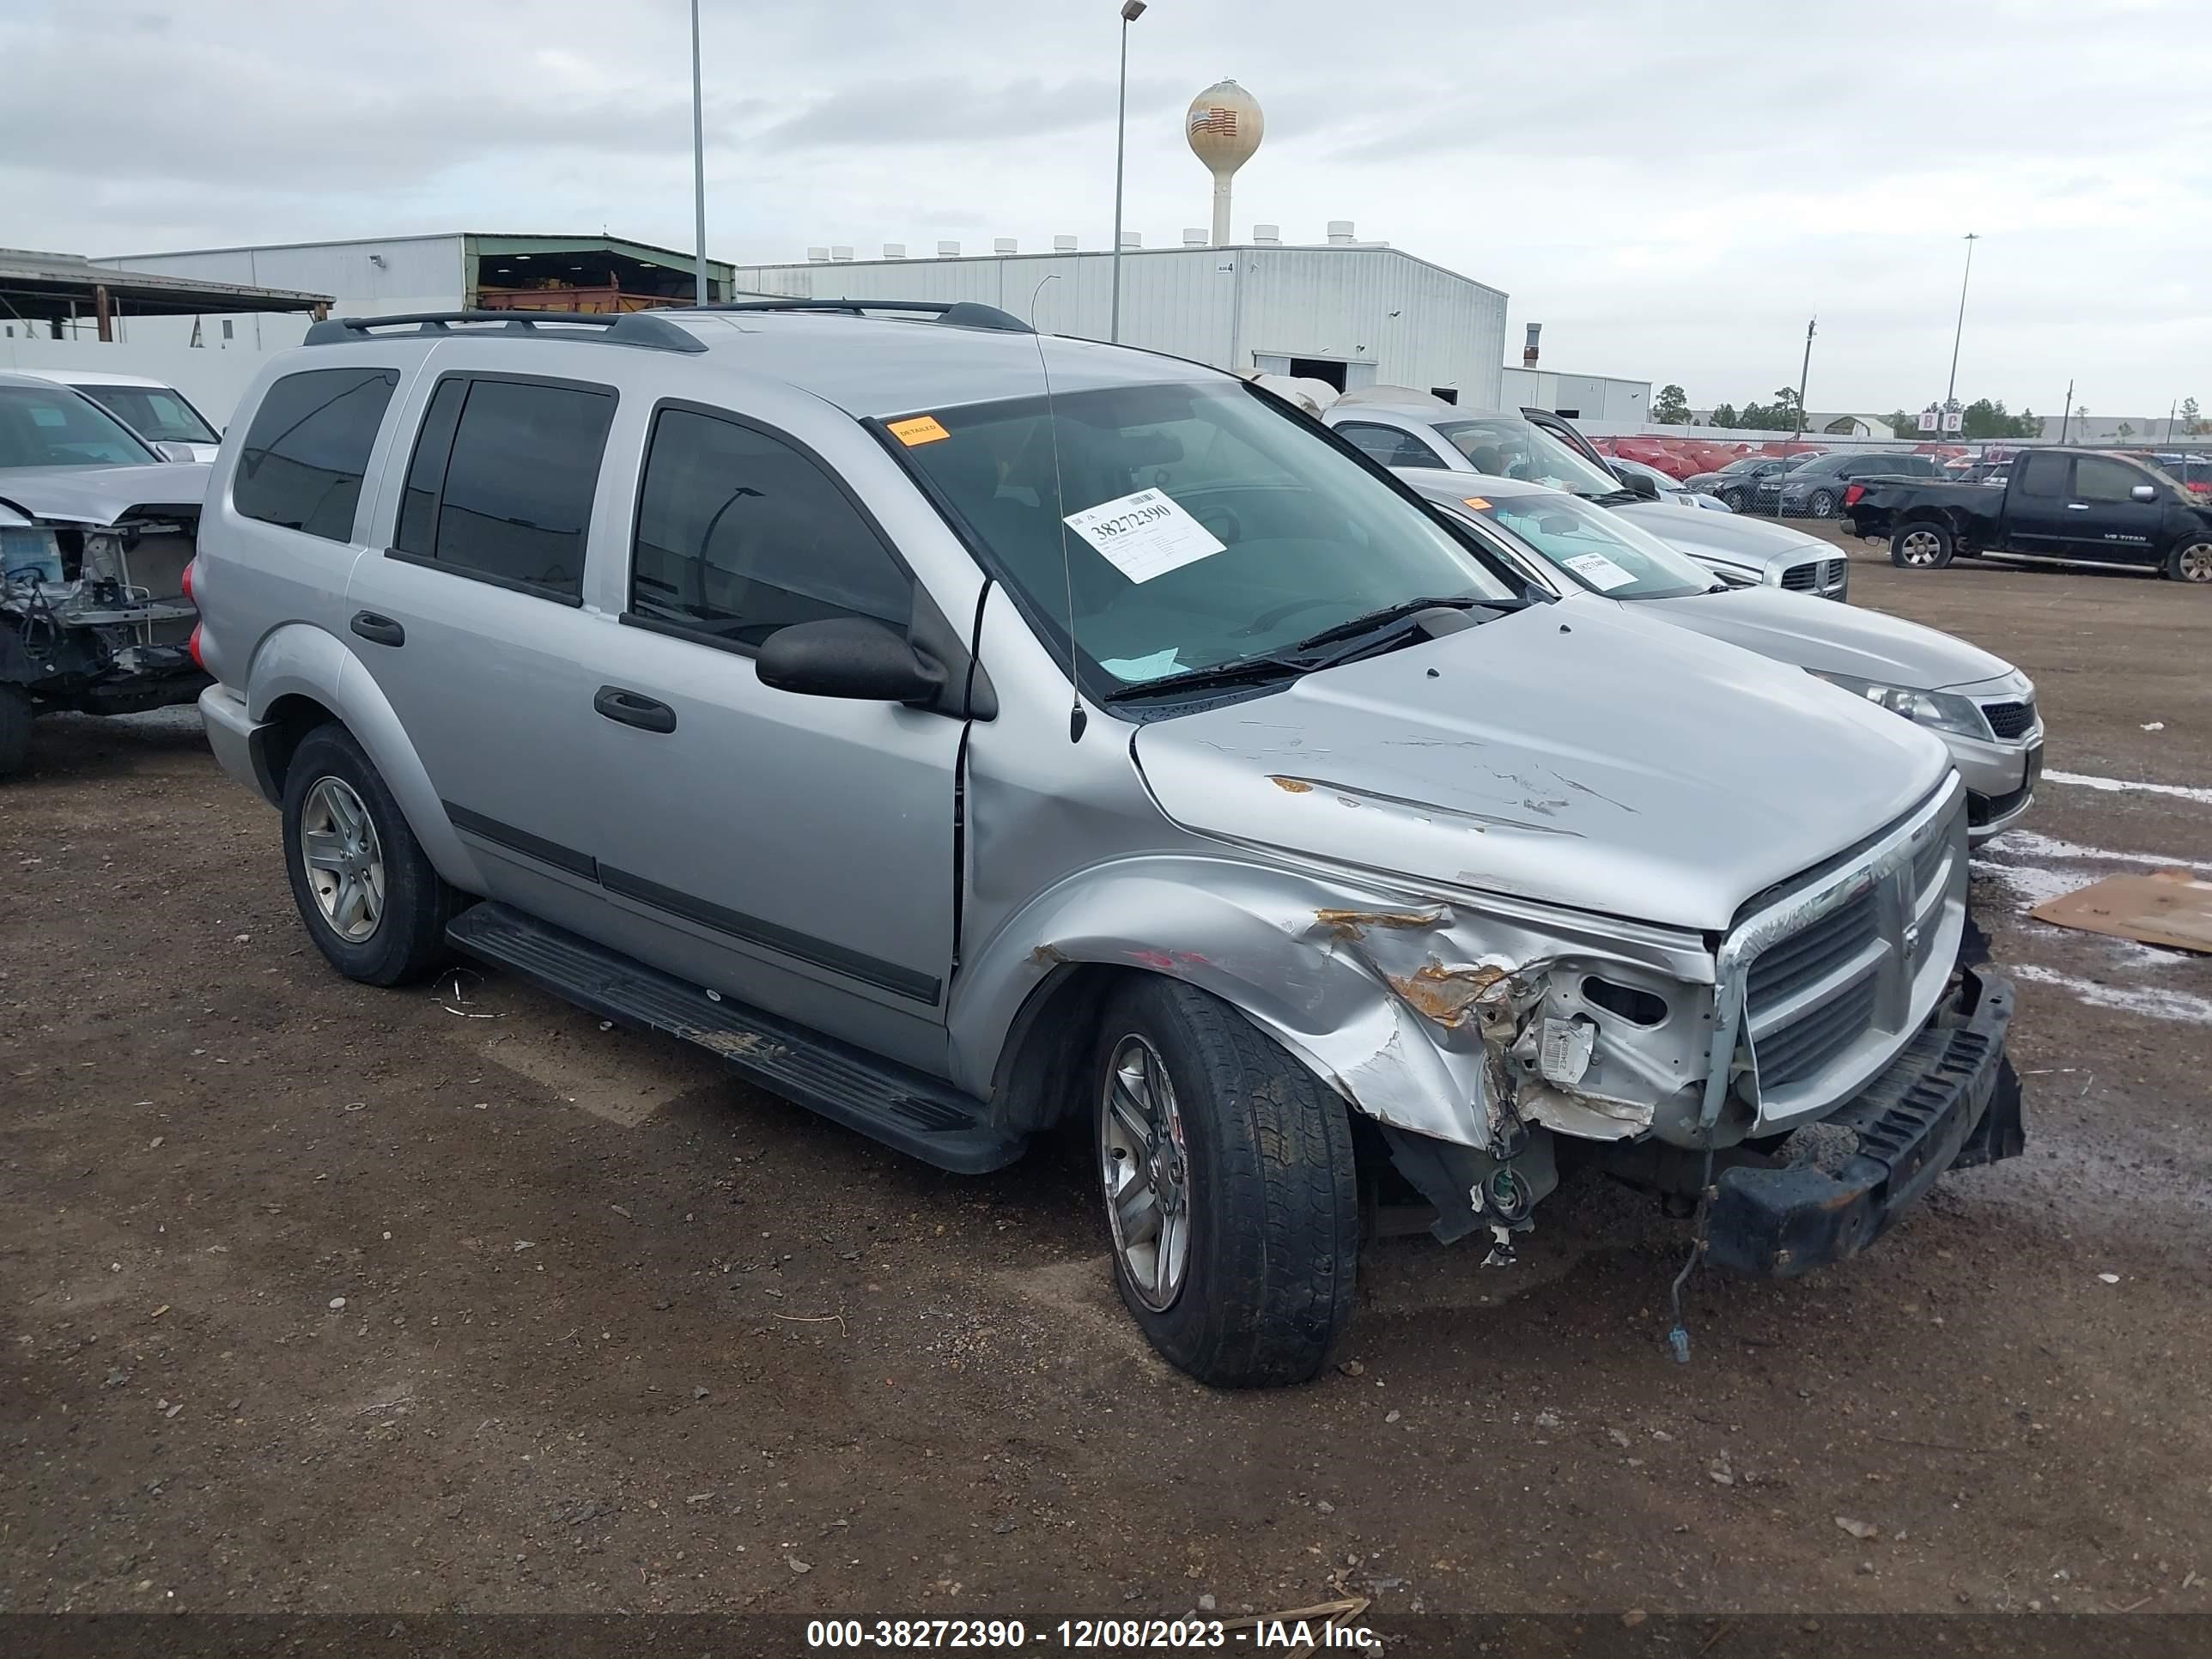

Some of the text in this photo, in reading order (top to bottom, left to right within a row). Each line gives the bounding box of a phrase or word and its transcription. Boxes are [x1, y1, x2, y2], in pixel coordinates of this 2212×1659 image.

[1228, 263, 1233, 273] 4
[1923, 415, 1933, 428] B
[1948, 415, 1958, 429] C
[900, 425, 936, 436] DETAILED
[1091, 504, 1171, 540] 38272390
